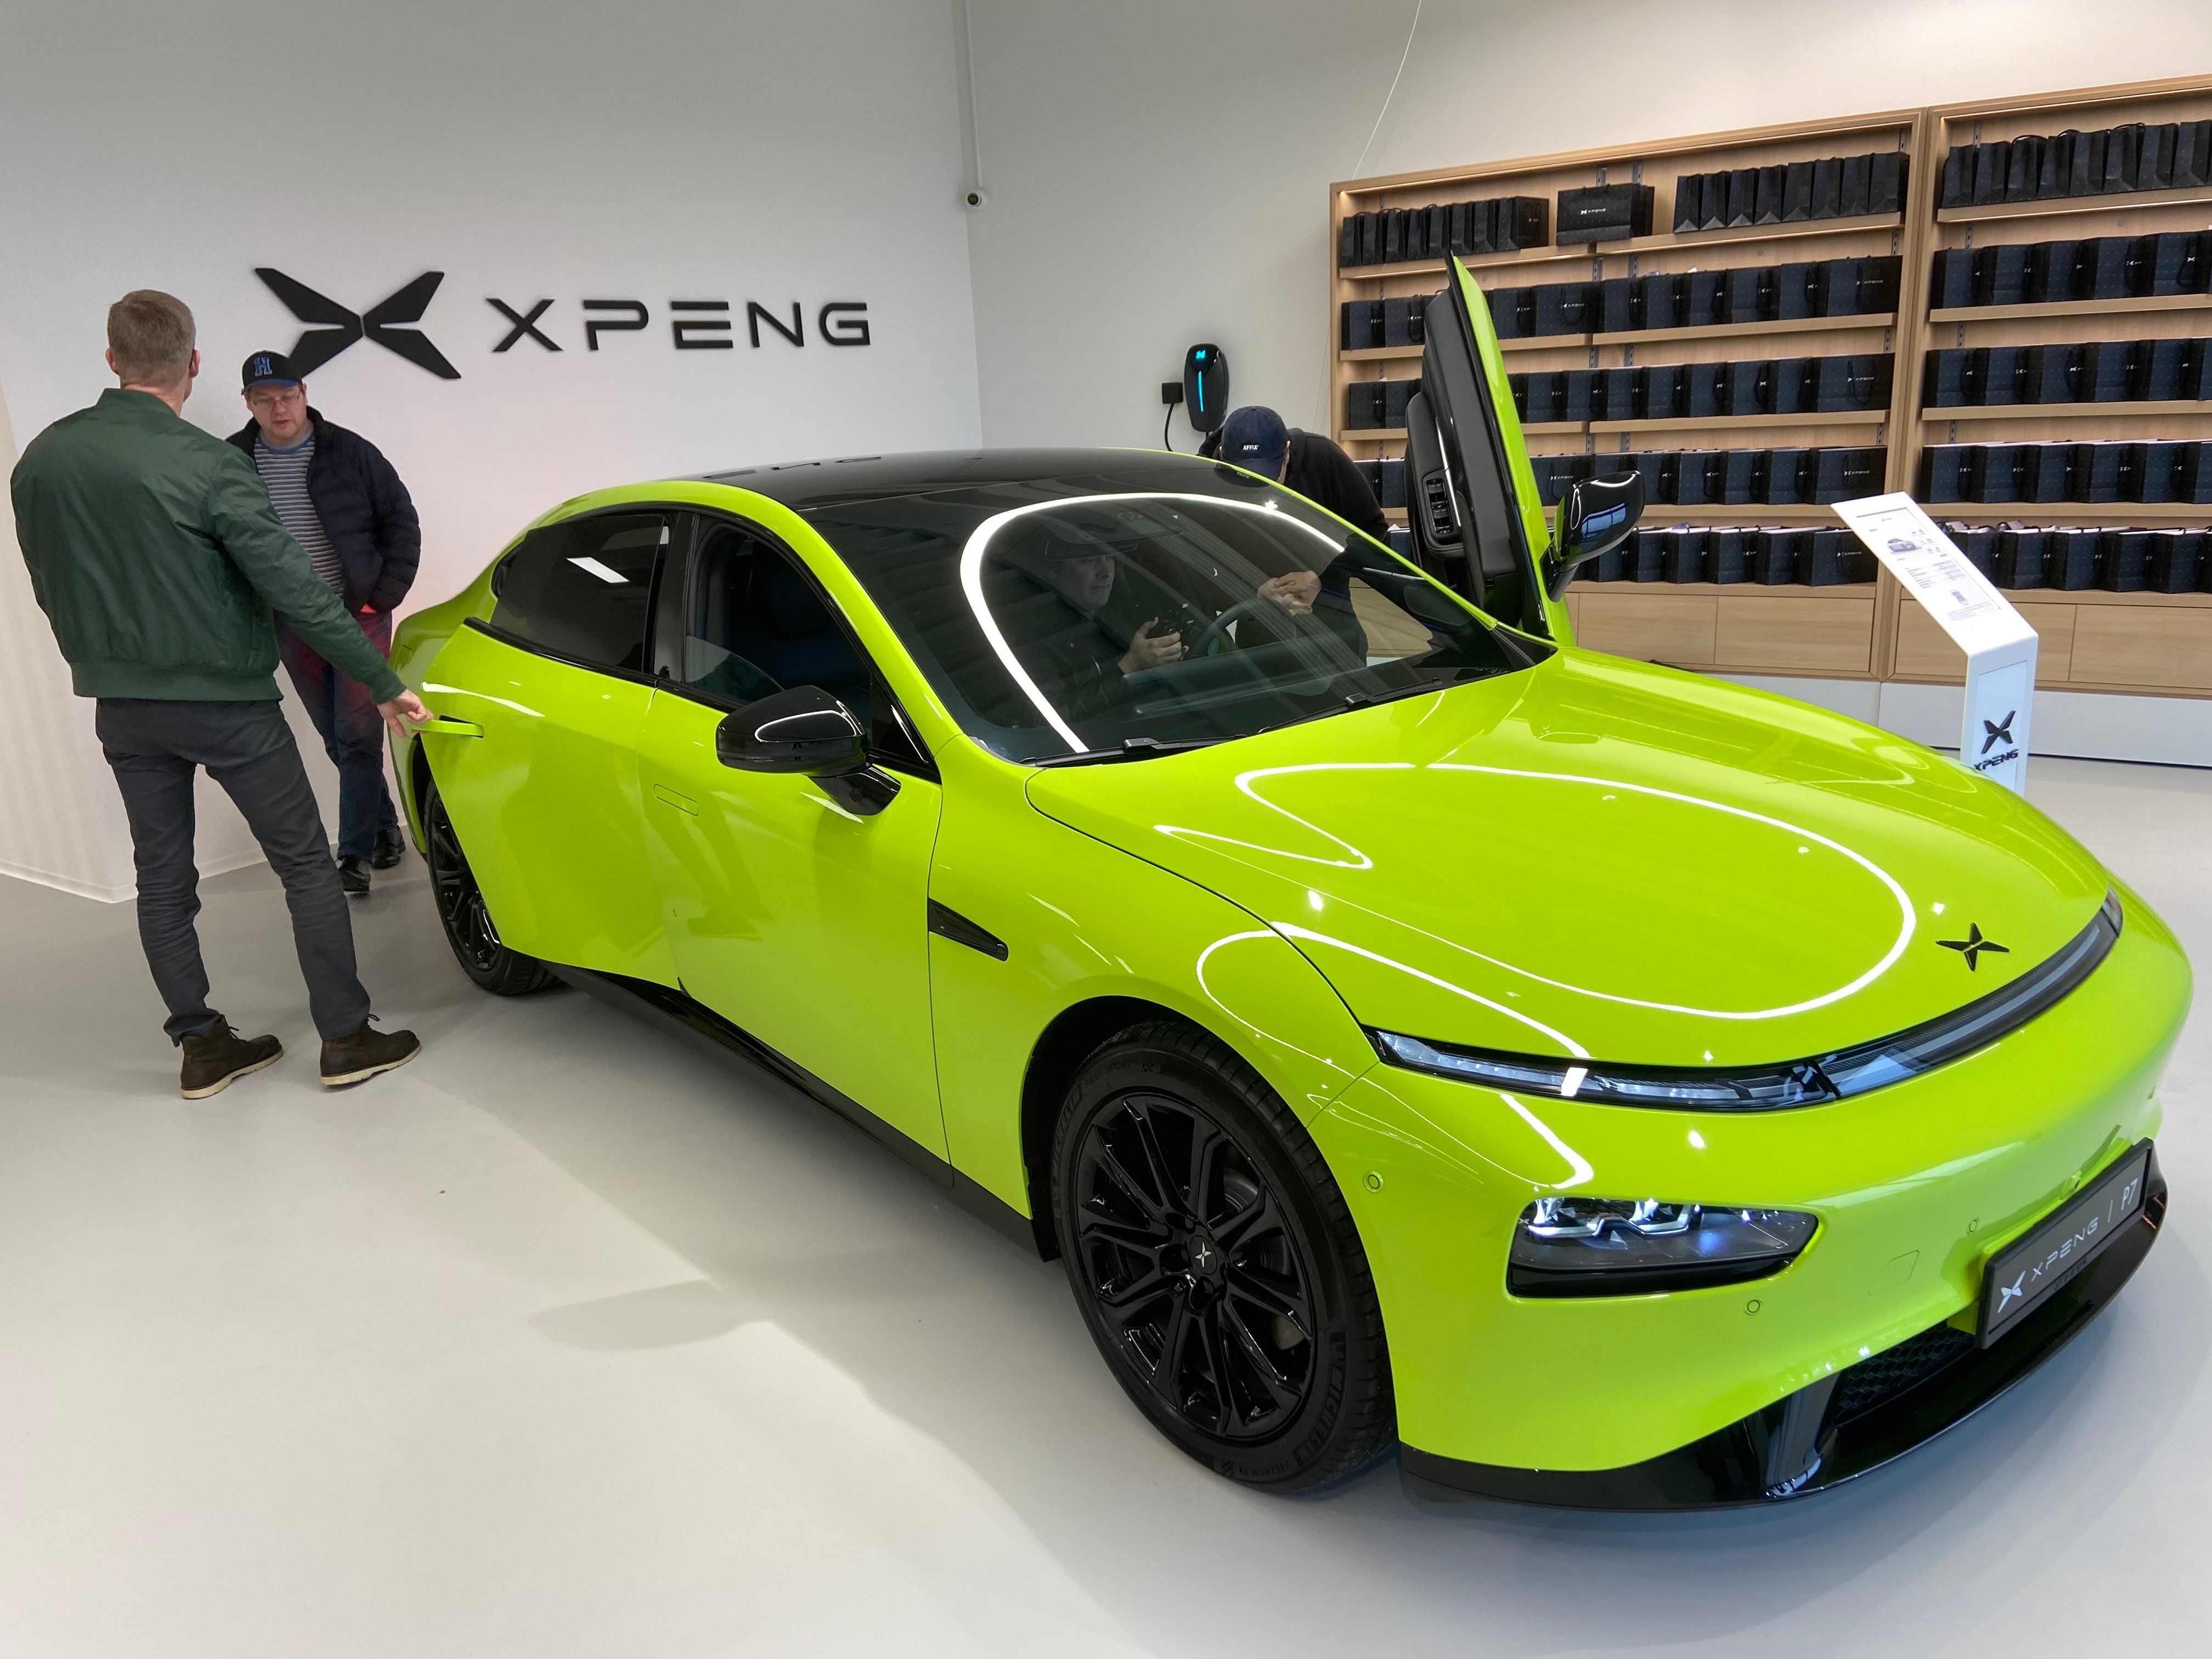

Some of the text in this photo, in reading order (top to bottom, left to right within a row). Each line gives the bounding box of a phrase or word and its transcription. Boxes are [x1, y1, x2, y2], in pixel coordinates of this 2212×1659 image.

[486, 298, 870, 352] XPENG
[254, 357, 272, 377] H
[1974, 748, 2019, 771] XPENG
[2031, 1178, 2138, 1283] XPENG P7
